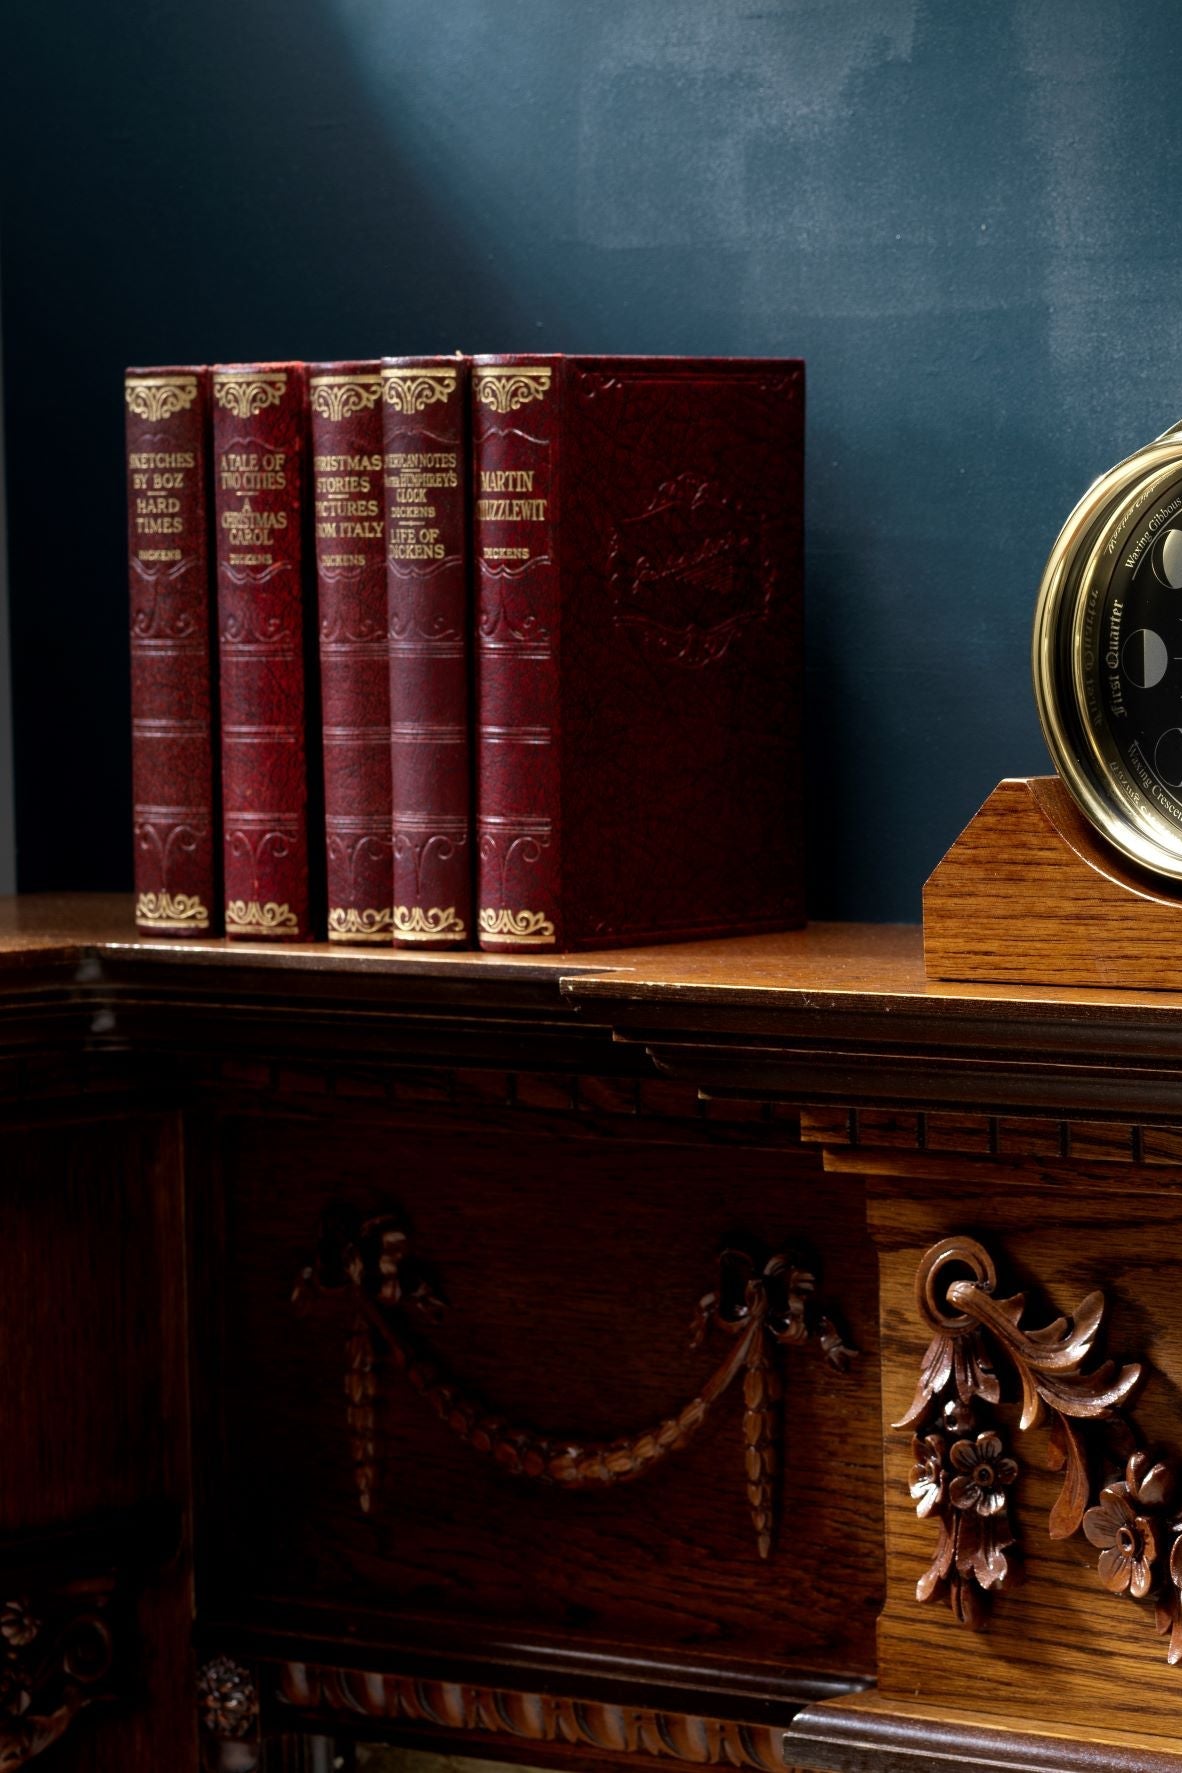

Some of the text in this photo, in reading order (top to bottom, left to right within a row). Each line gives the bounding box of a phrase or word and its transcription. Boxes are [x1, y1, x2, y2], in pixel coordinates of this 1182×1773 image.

[228, 454, 259, 471] TALE
[263, 453, 286, 471] OF
[419, 453, 457, 469] NOTES
[133, 472, 184, 489] BY BOZ
[221, 472, 287, 490] TWO CITIES
[480, 470, 535, 492] MARTIN
[396, 488, 428, 503] CLOCK
[136, 498, 180, 514] HARD
[242, 497, 252, 514] A
[390, 506, 436, 518] DICKENS
[136, 517, 183, 534] TIMES
[340, 521, 384, 538] ITALY
[1125, 531, 1152, 568] Waxing
[1149, 497, 1182, 531] Gibbous
[229, 528, 274, 546] CAROL
[390, 528, 440, 544] LIFE OF
[389, 544, 445, 560] DICKENS
[483, 547, 530, 560] DICKENS
[1105, 599, 1128, 718] First Quarter
[1127, 743, 1153, 789] Waxing
